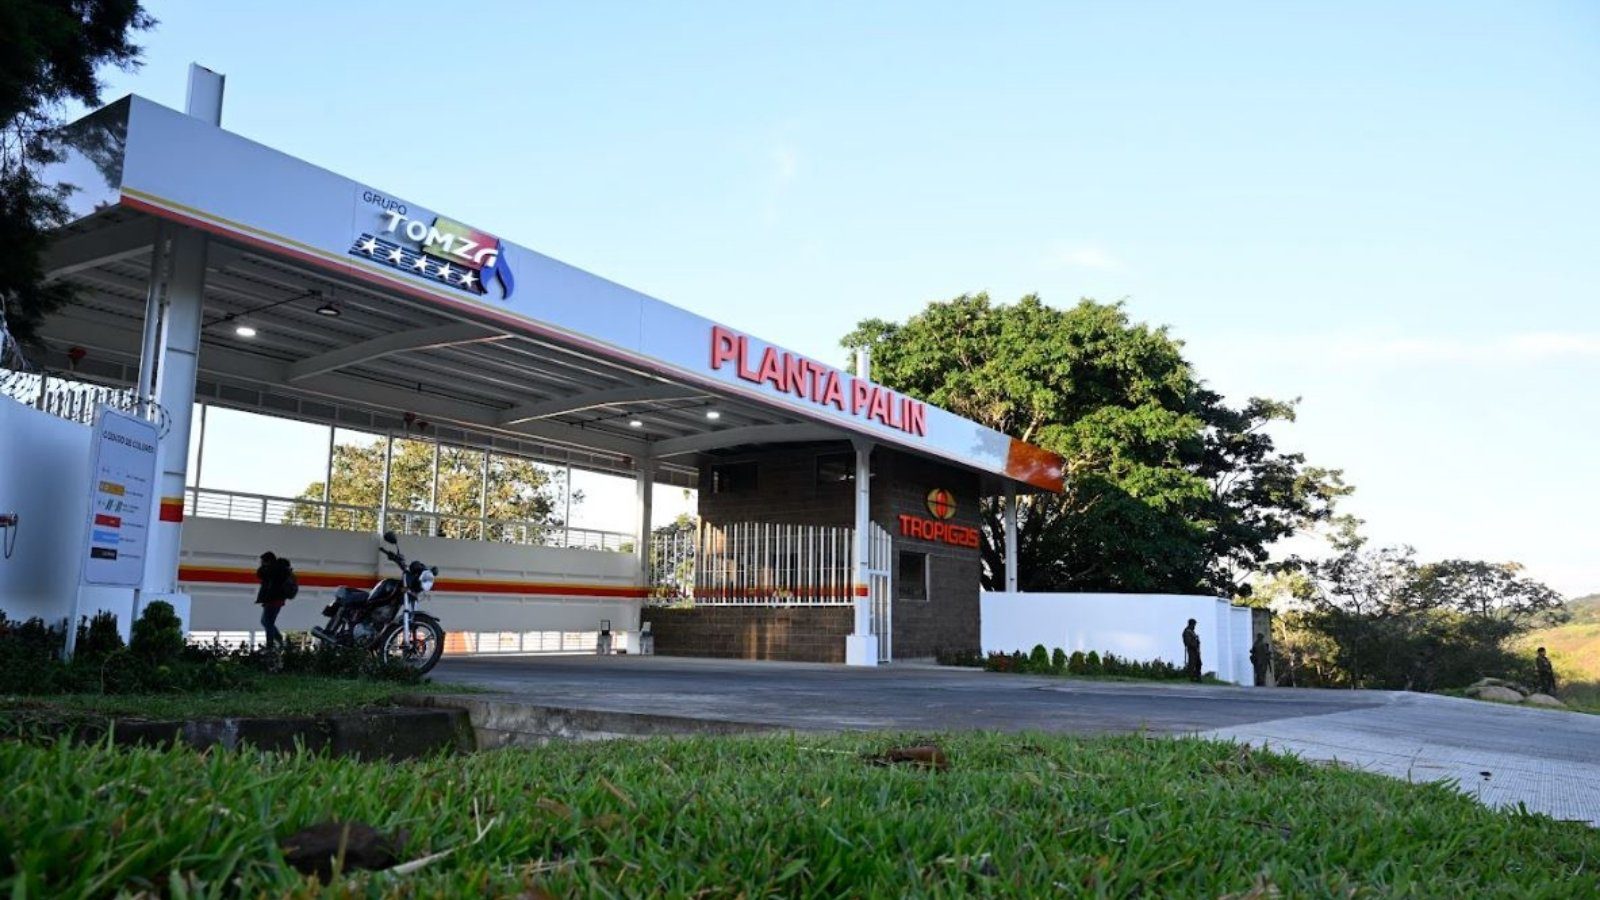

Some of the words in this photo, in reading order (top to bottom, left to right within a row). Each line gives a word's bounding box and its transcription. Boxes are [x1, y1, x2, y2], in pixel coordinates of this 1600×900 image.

[363, 191, 407, 215] GRUPO
[711, 325, 845, 411] PLANTA
[851, 378, 927, 437] PALIN
